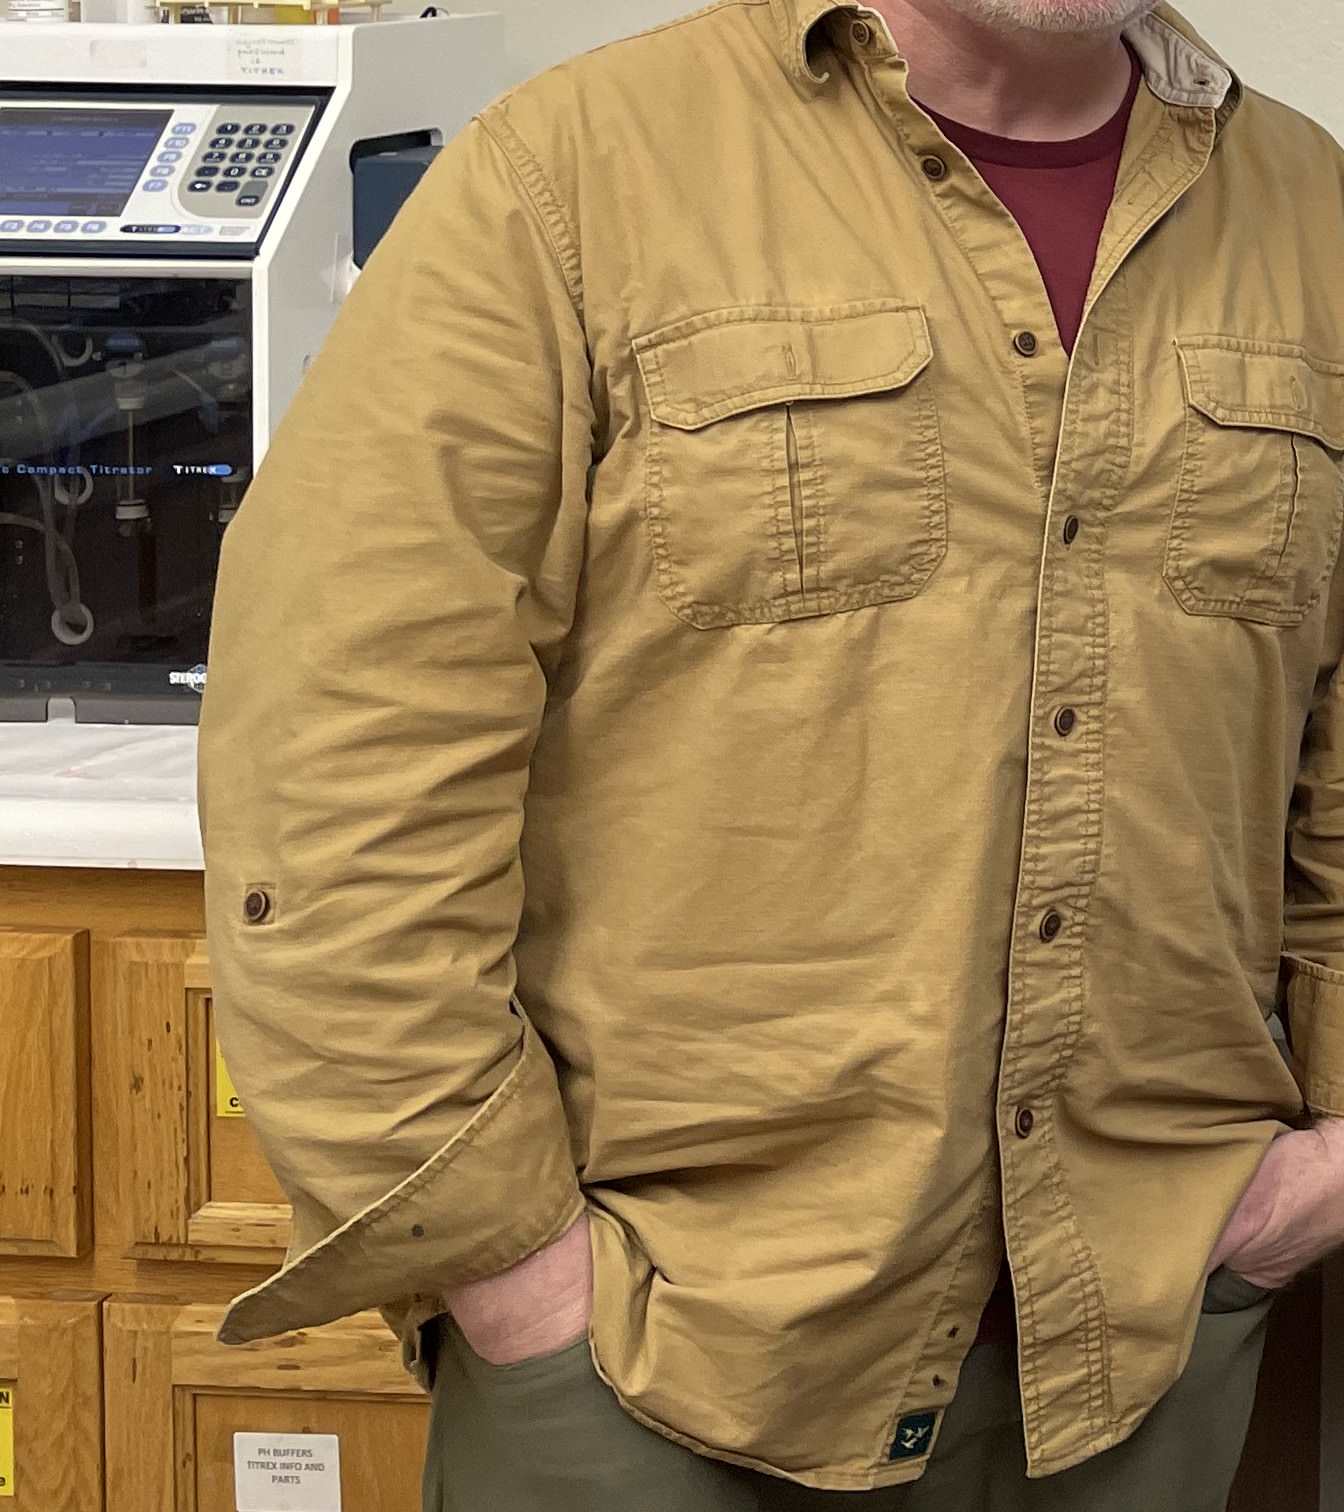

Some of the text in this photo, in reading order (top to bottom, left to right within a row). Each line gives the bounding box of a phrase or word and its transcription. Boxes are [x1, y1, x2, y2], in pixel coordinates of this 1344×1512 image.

[17, 464, 82, 476] Compact
[90, 464, 152, 475] Titrator
[273, 1448, 313, 1457] BUFFERS
[280, 1462, 302, 1471] INFO
[304, 1463, 325, 1472] AND
[271, 1475, 301, 1484] PARTS
